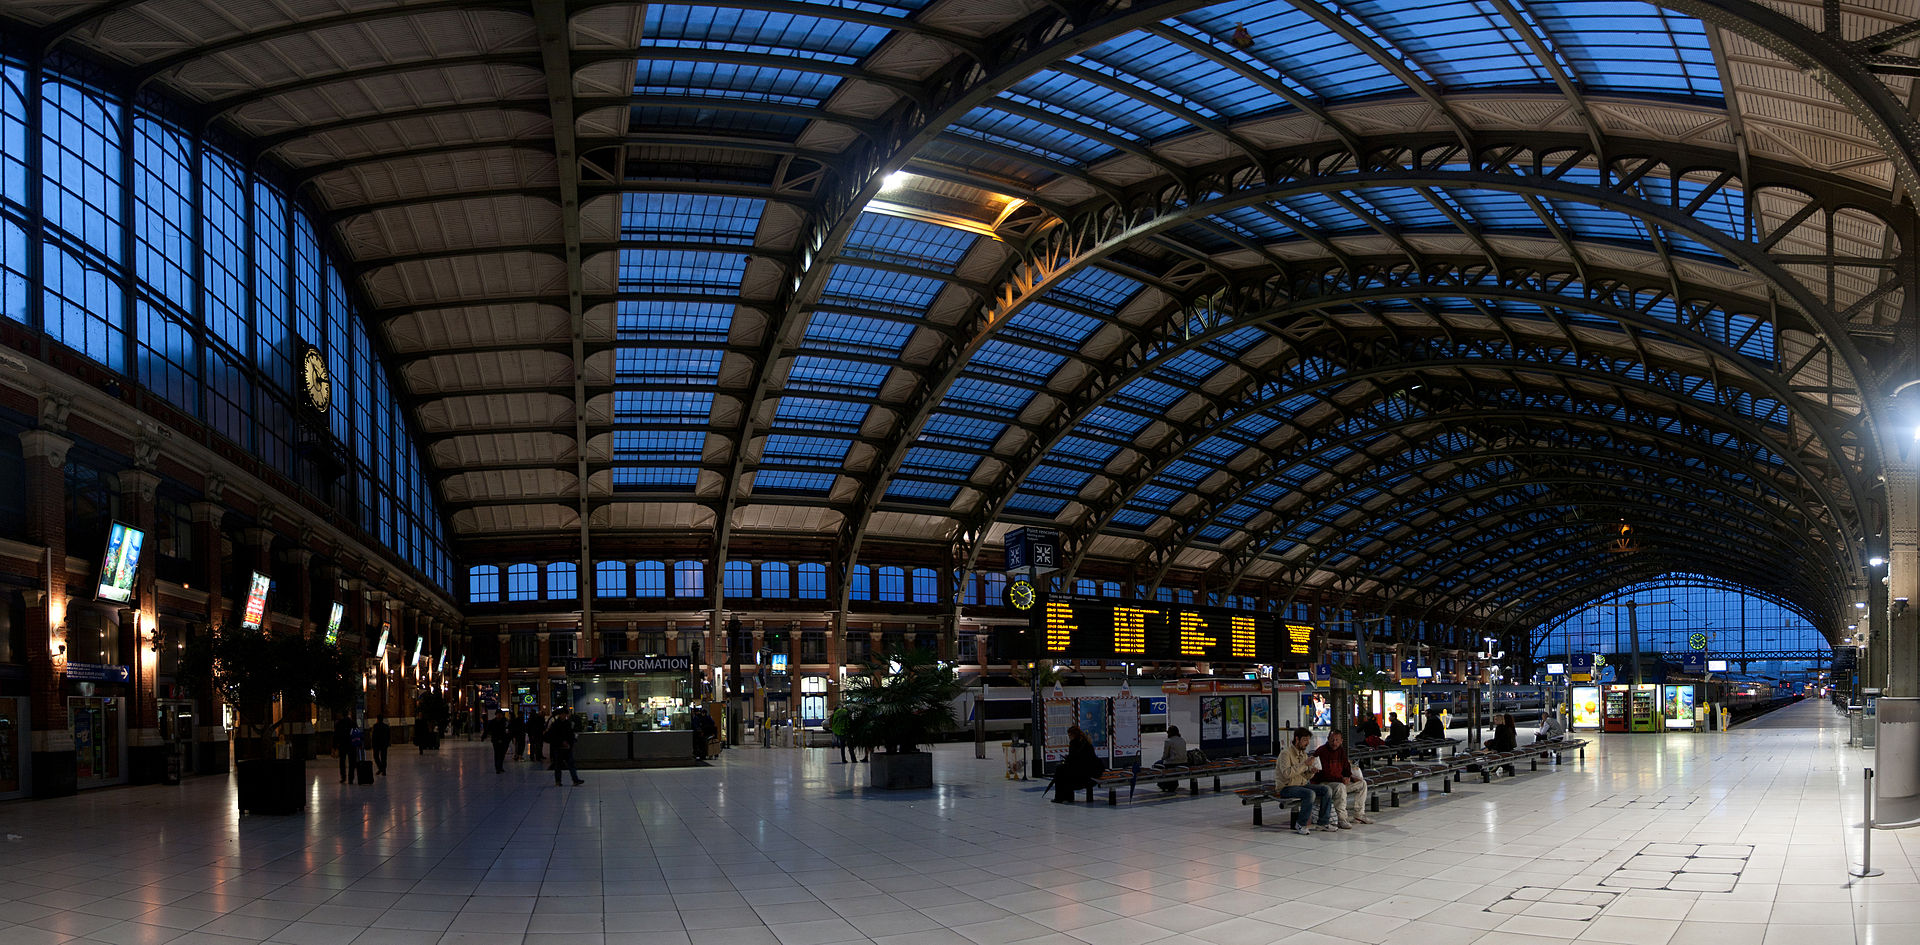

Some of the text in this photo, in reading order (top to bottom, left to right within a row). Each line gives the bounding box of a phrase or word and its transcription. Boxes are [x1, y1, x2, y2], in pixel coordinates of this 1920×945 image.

[609, 658, 688, 670] INFORMATION
[1578, 657, 1584, 666] 3
[1691, 656, 1697, 664] 2
[1151, 701, 1166, 711] TG
